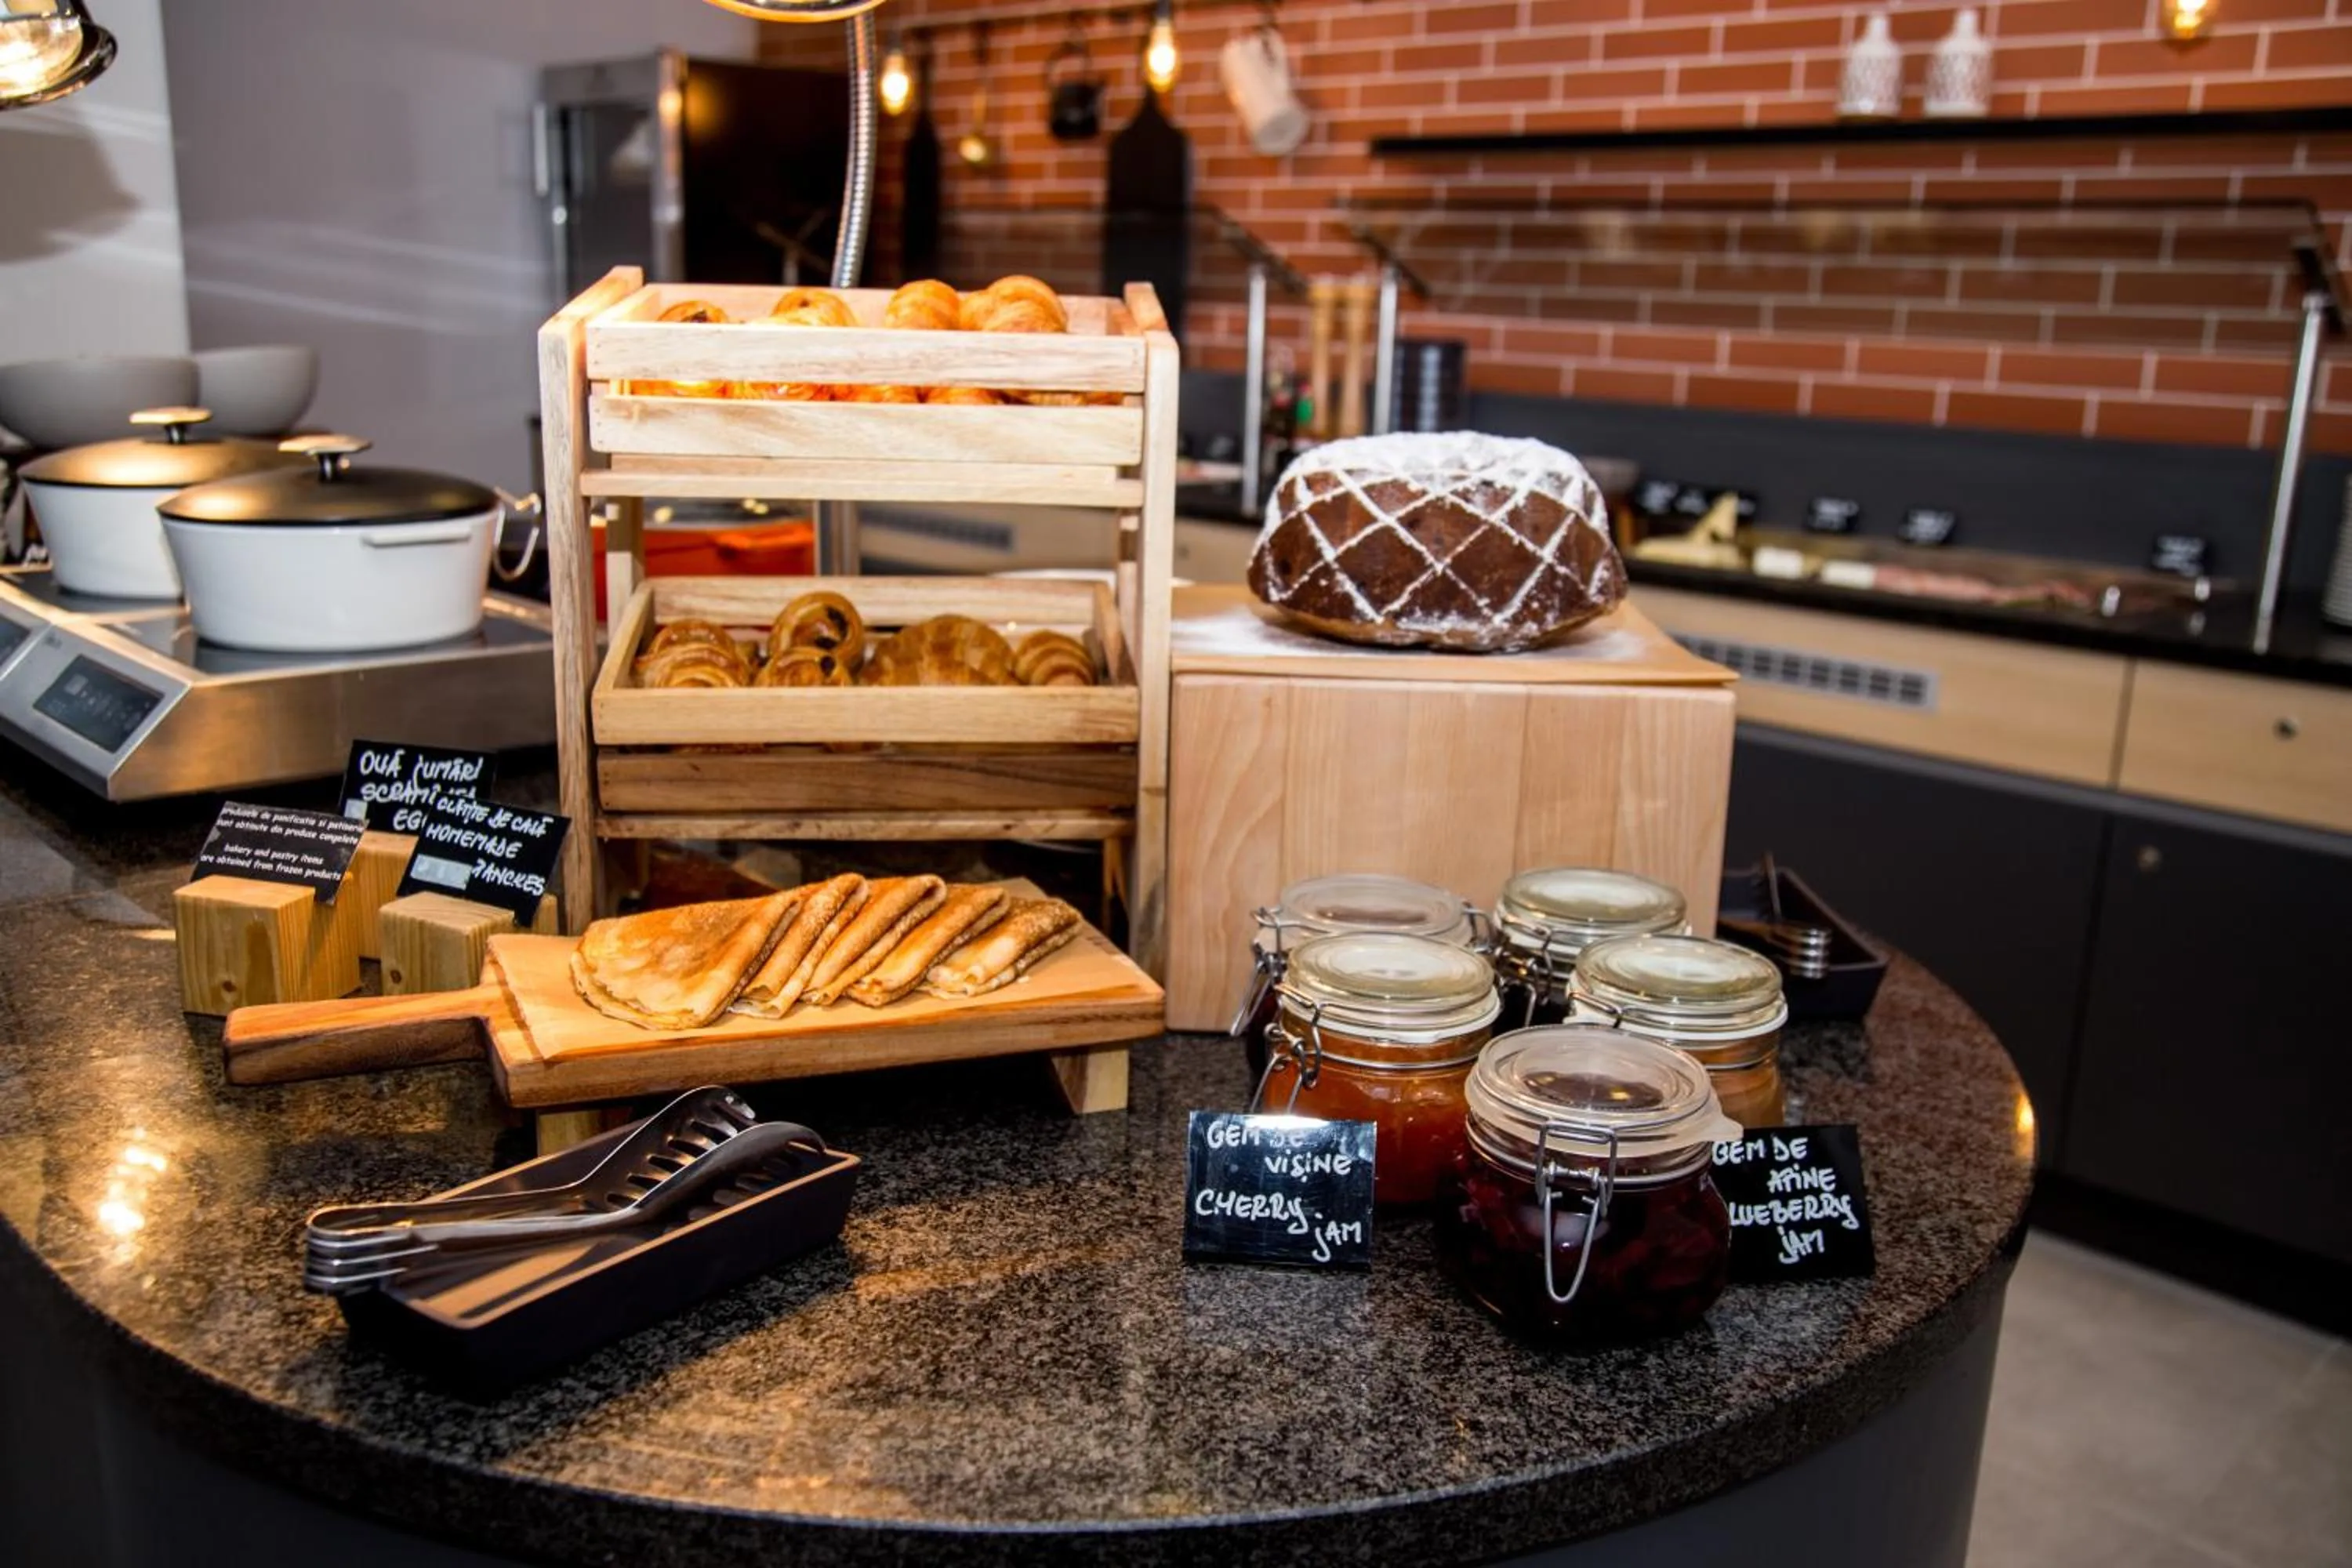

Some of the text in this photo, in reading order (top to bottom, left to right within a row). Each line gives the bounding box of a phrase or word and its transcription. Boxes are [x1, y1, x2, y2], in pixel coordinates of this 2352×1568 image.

[260, 810, 270, 820] de
[270, 824, 283, 834] din
[284, 828, 318, 840] produse
[426, 822, 522, 858] HOMEMADE
[201, 854, 341, 881] are obtained from frozen products
[223, 844, 324, 866] bakery and pastry items
[1772, 1134, 1809, 1162] DE
[1729, 1193, 1860, 1230] LUEBERRY
